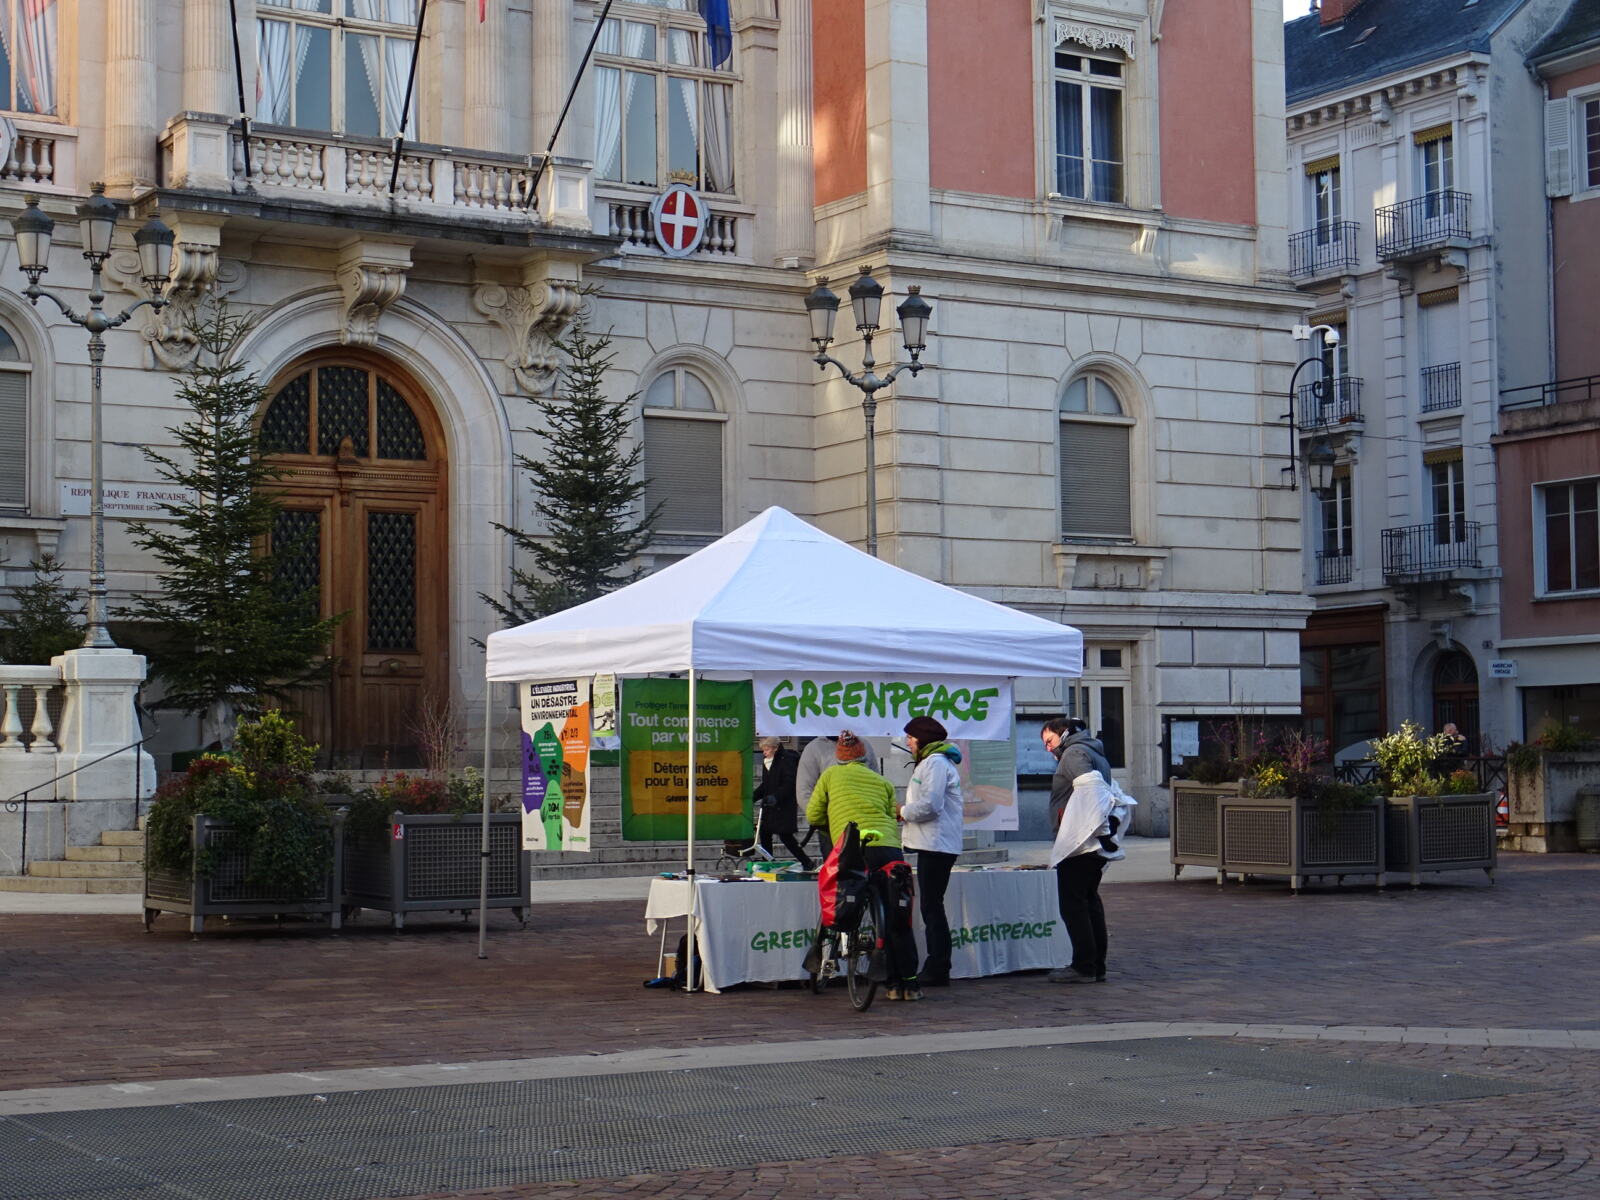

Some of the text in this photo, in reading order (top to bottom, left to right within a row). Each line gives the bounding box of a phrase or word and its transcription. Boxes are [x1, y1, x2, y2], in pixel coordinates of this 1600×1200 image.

[71, 489, 129, 499] REPLIQUE
[103, 502, 144, 511] SEPTEMBRE
[531, 698, 541, 709] UN
[541, 695, 578, 708] DÉSASTRE
[768, 679, 999, 725] GREENPEACE
[531, 708, 578, 721] ENVIRONNEMENTAL
[628, 713, 740, 729] Tout commence
[652, 731, 673, 745] par
[645, 775, 729, 789] pour la anète
[950, 921, 1057, 950] GREENPEACE
